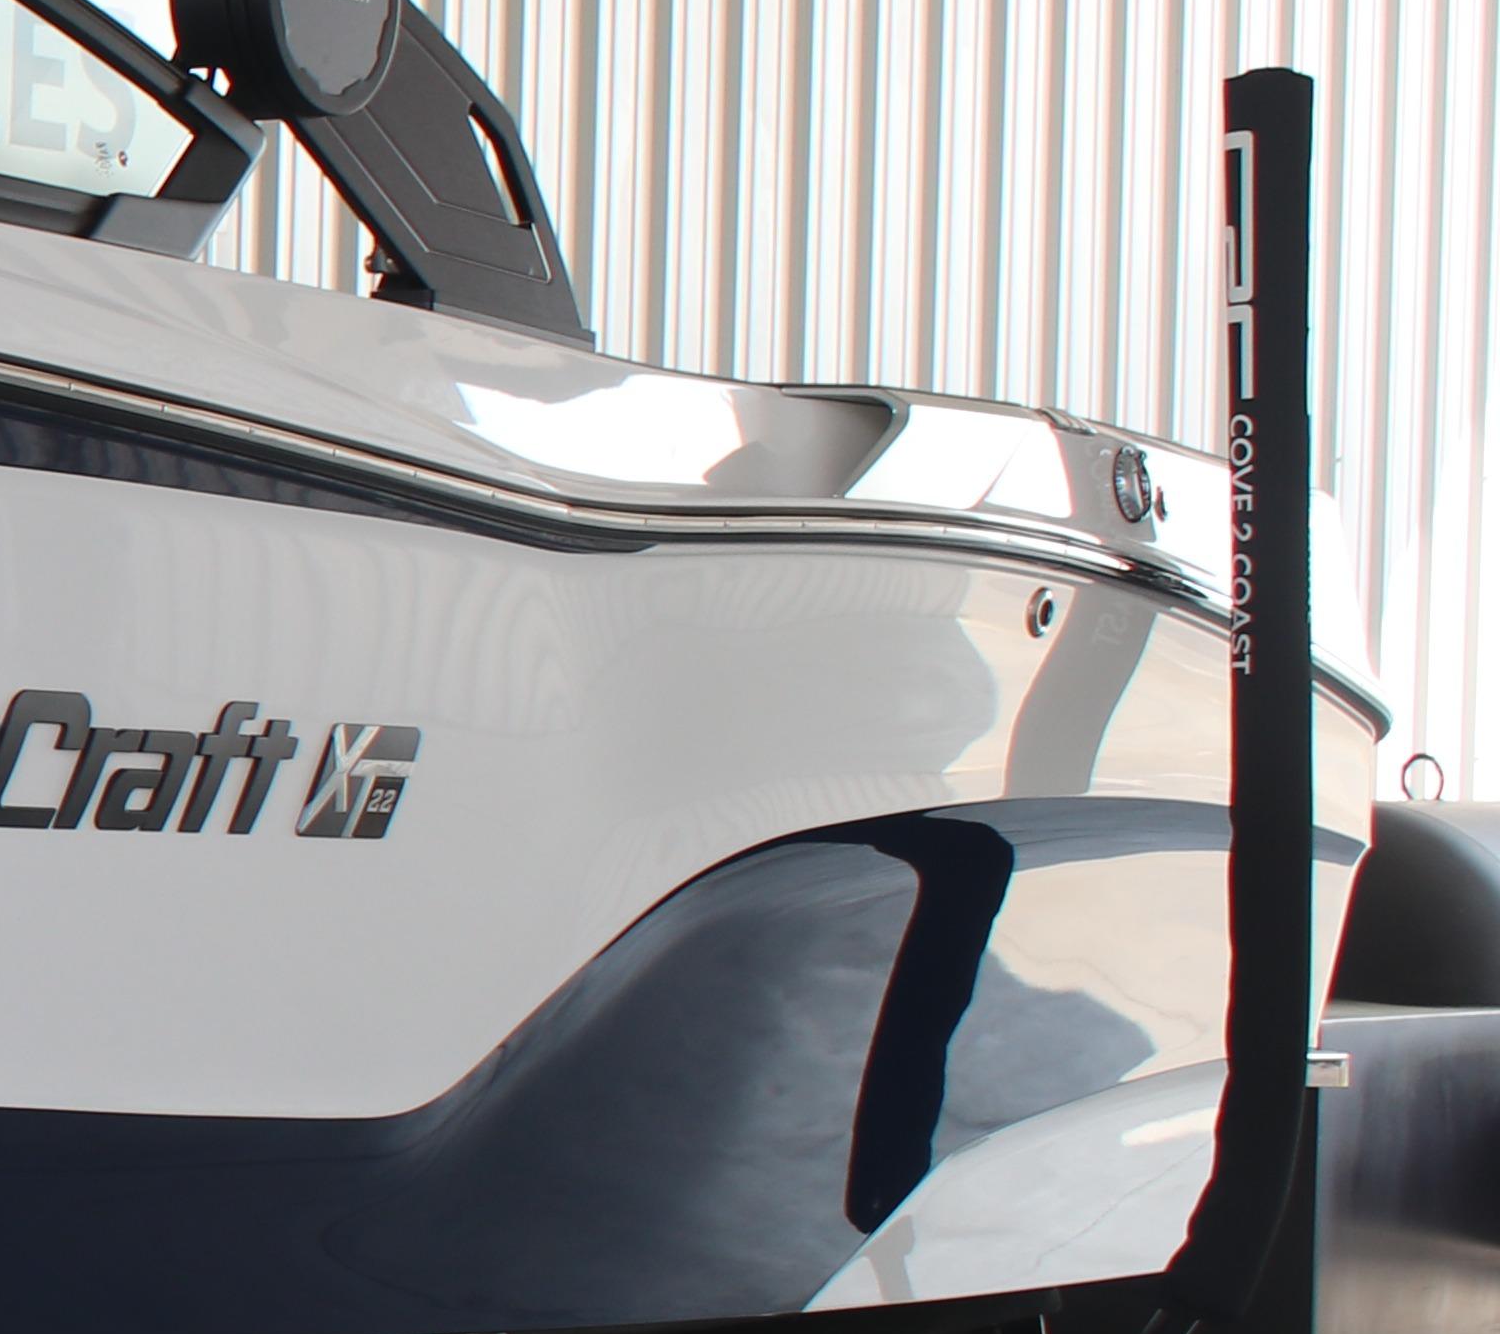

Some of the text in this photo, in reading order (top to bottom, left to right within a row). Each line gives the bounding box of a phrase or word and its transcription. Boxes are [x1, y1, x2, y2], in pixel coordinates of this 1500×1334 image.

[1230, 414, 1254, 513] COVE
[1231, 522, 1253, 543] 2
[1231, 553, 1253, 675] COAST
[366, 788, 398, 814] 22
